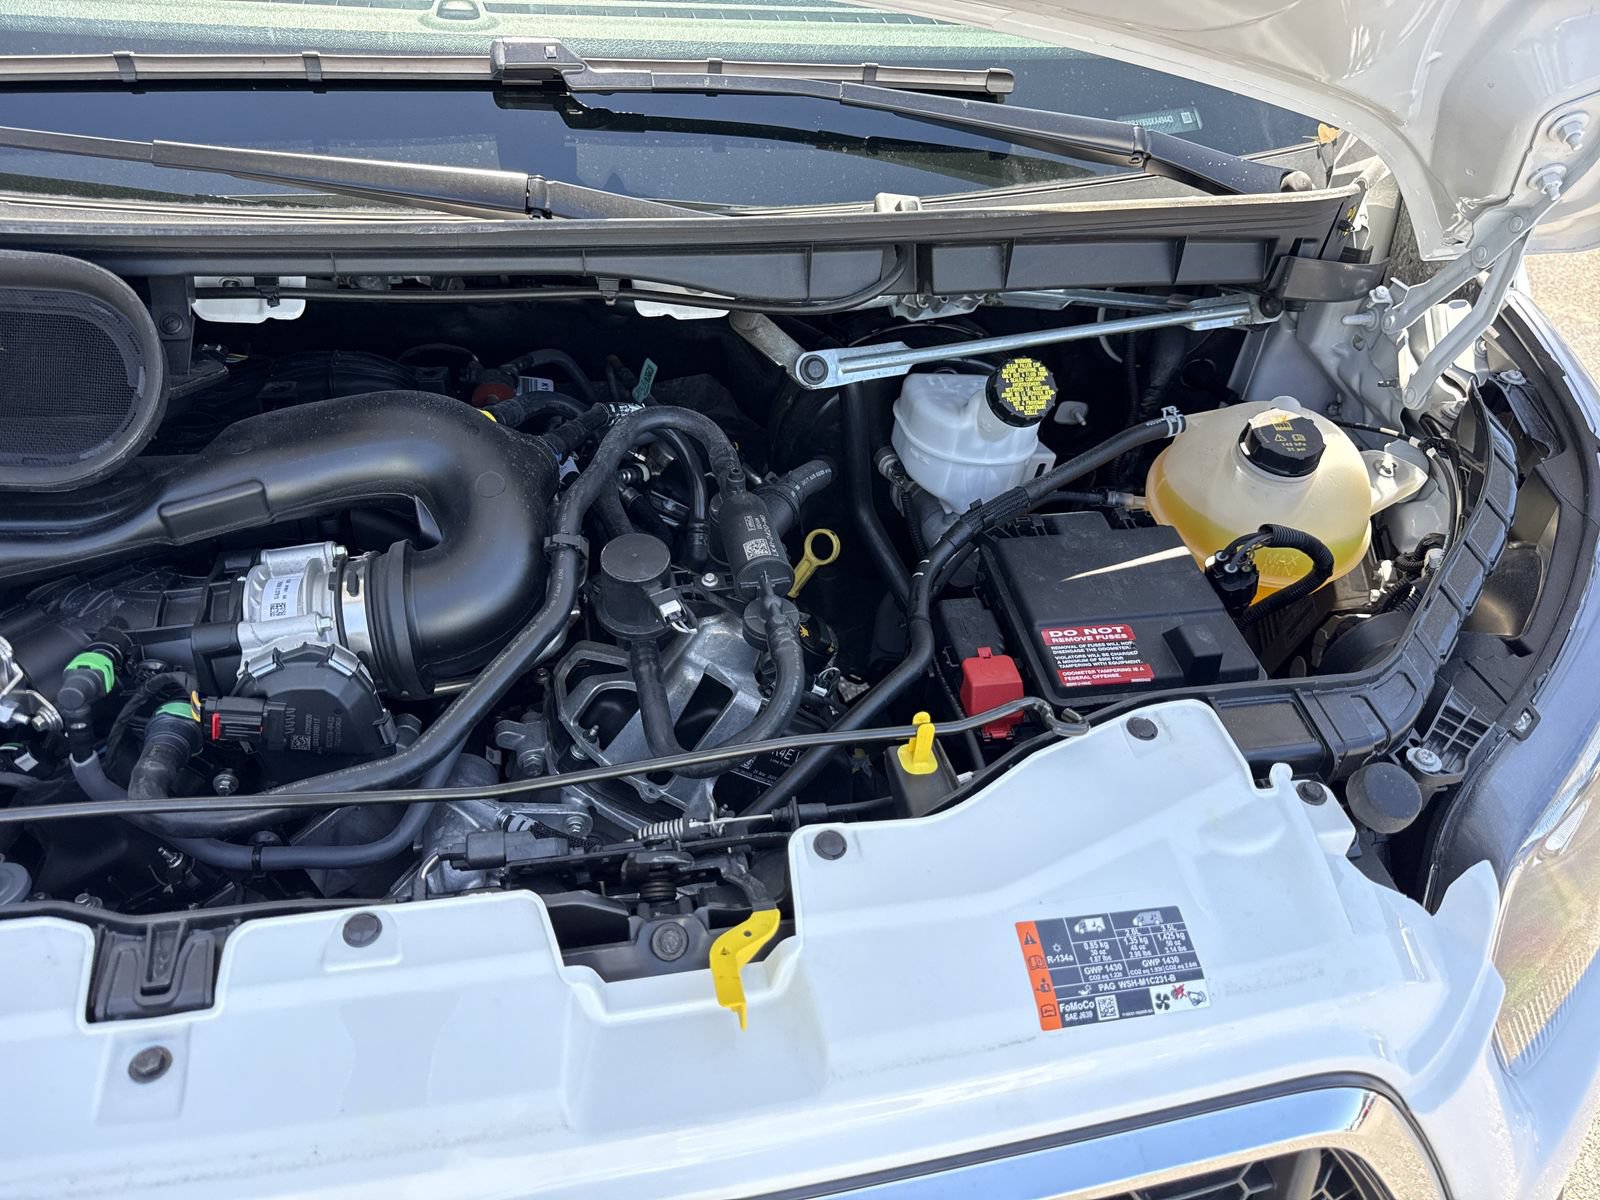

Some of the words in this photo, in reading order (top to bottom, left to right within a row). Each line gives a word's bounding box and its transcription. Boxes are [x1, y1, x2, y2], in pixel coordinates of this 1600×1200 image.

[1264, 552, 1300, 567] MAX
[1085, 626, 1124, 635] NOT
[1138, 936, 1149, 945] kg
[1176, 932, 1185, 941] kg
[1100, 942, 1109, 950] kg
[1047, 954, 1074, 964] R-134a
[1142, 959, 1160, 968] GWP
[1162, 956, 1180, 964] 1430
[1084, 966, 1103, 976] GWP
[1105, 963, 1123, 972] 1430
[1098, 982, 1116, 992] PAG
[1118, 974, 1176, 989] WSH-M1C231-B
[1060, 1000, 1095, 1012] FoMoCo
[1080, 1011, 1094, 1020] J639
